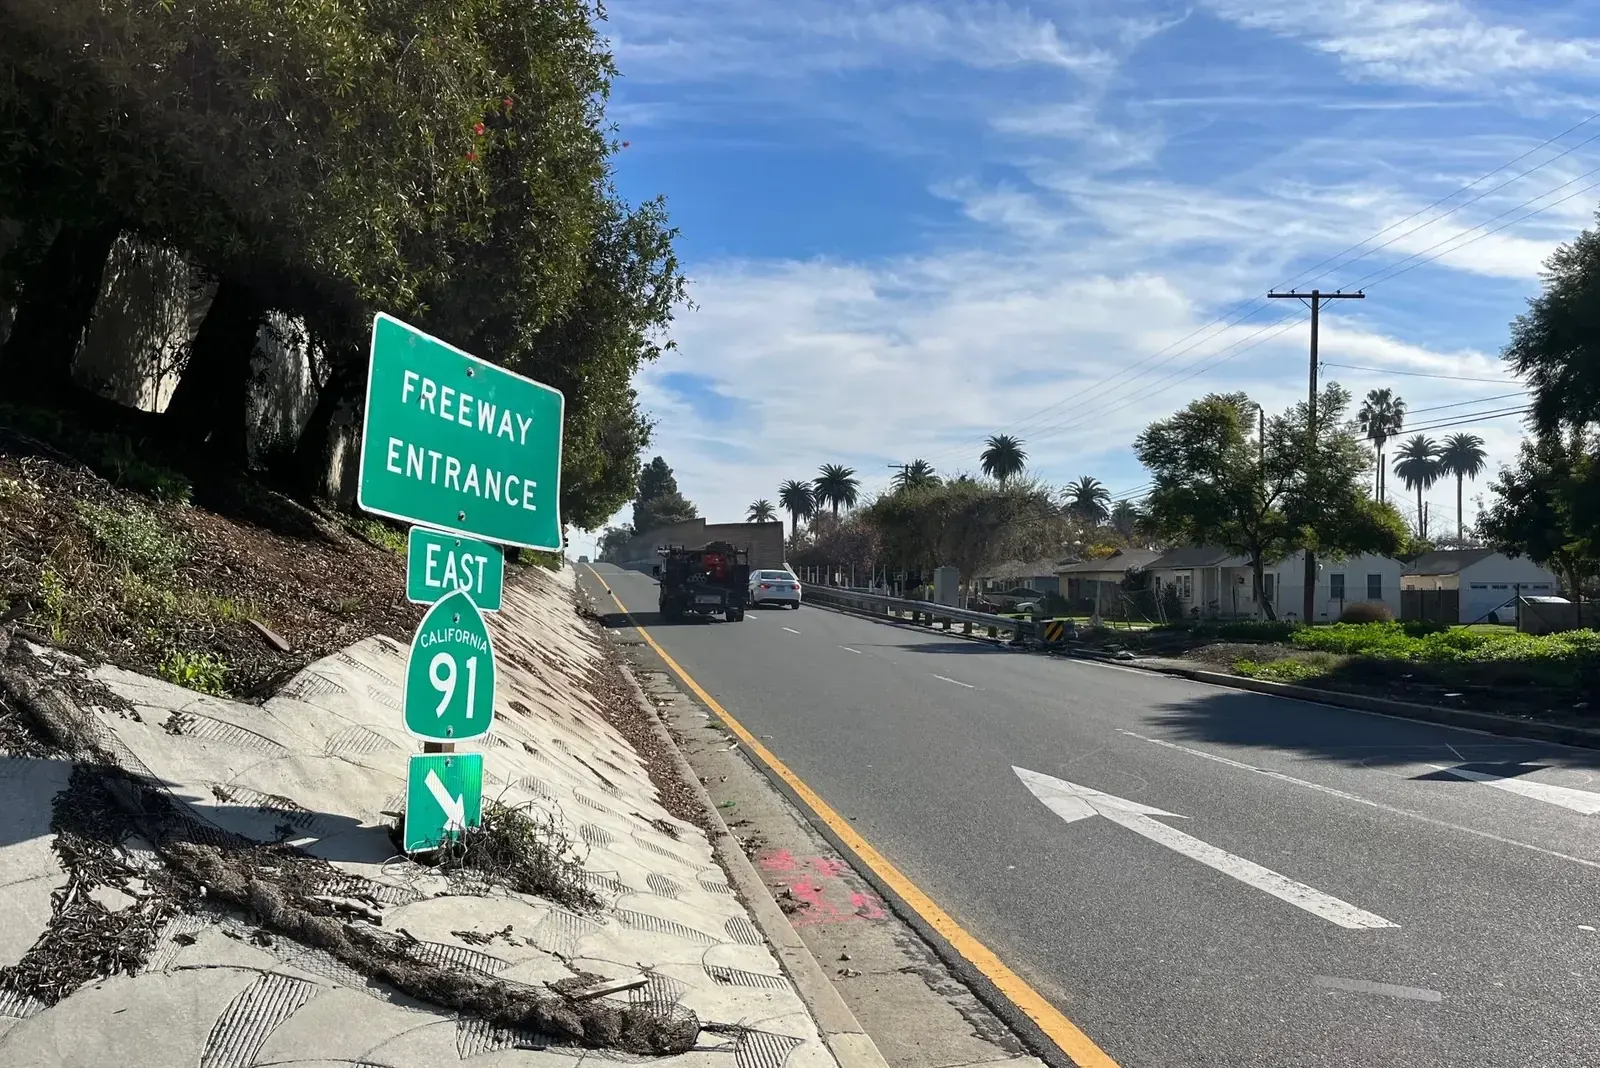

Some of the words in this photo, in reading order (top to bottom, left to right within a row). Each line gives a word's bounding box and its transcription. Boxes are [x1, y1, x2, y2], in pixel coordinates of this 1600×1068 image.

[402, 370, 532, 445] FREEWAY
[386, 437, 537, 511] ENTRANCE
[425, 544, 488, 594] EAST
[420, 627, 488, 654] CALIFORNIA
[429, 652, 477, 719] 91
